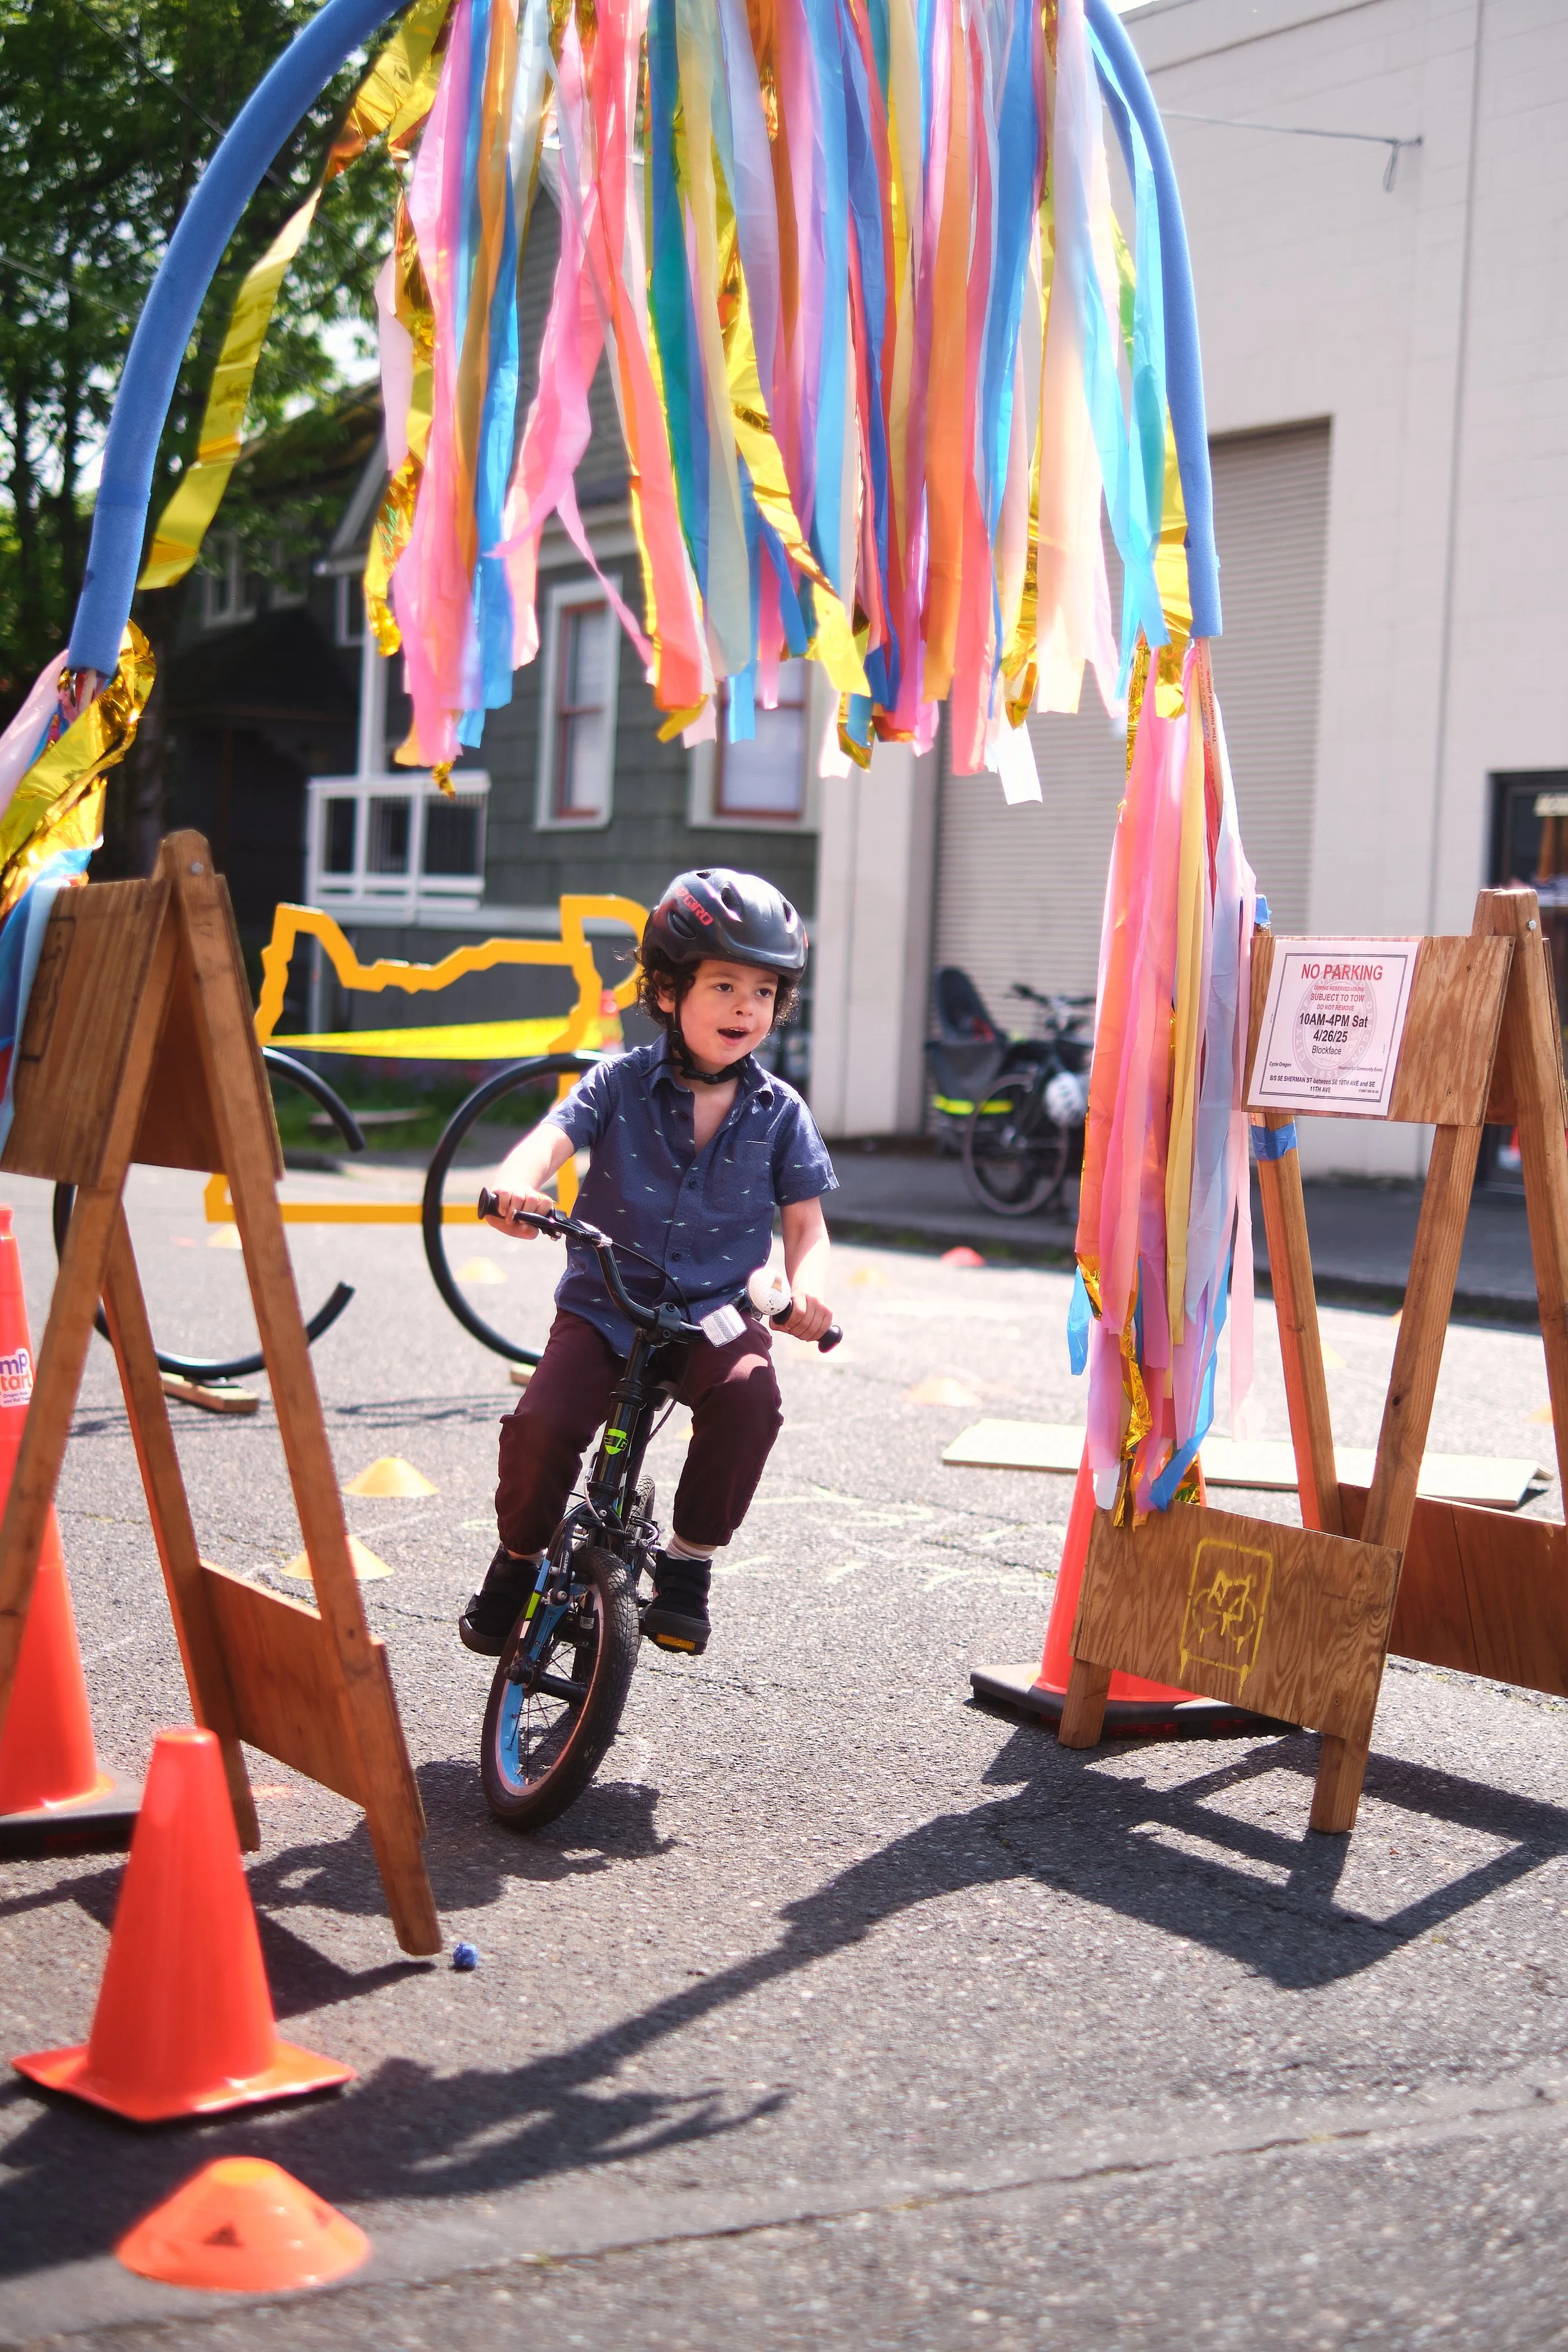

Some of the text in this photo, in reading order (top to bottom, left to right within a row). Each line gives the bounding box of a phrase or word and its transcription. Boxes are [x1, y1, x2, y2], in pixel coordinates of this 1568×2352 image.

[1301, 963, 1320, 979] NO
[1323, 964, 1383, 980] PARKING
[1310, 993, 1339, 1002] SUBJECT
[1300, 1012, 1368, 1028] 10AM-4PM Sat
[1313, 1029, 1348, 1042] 4/26/25
[1311, 1045, 1342, 1055] Blockface
